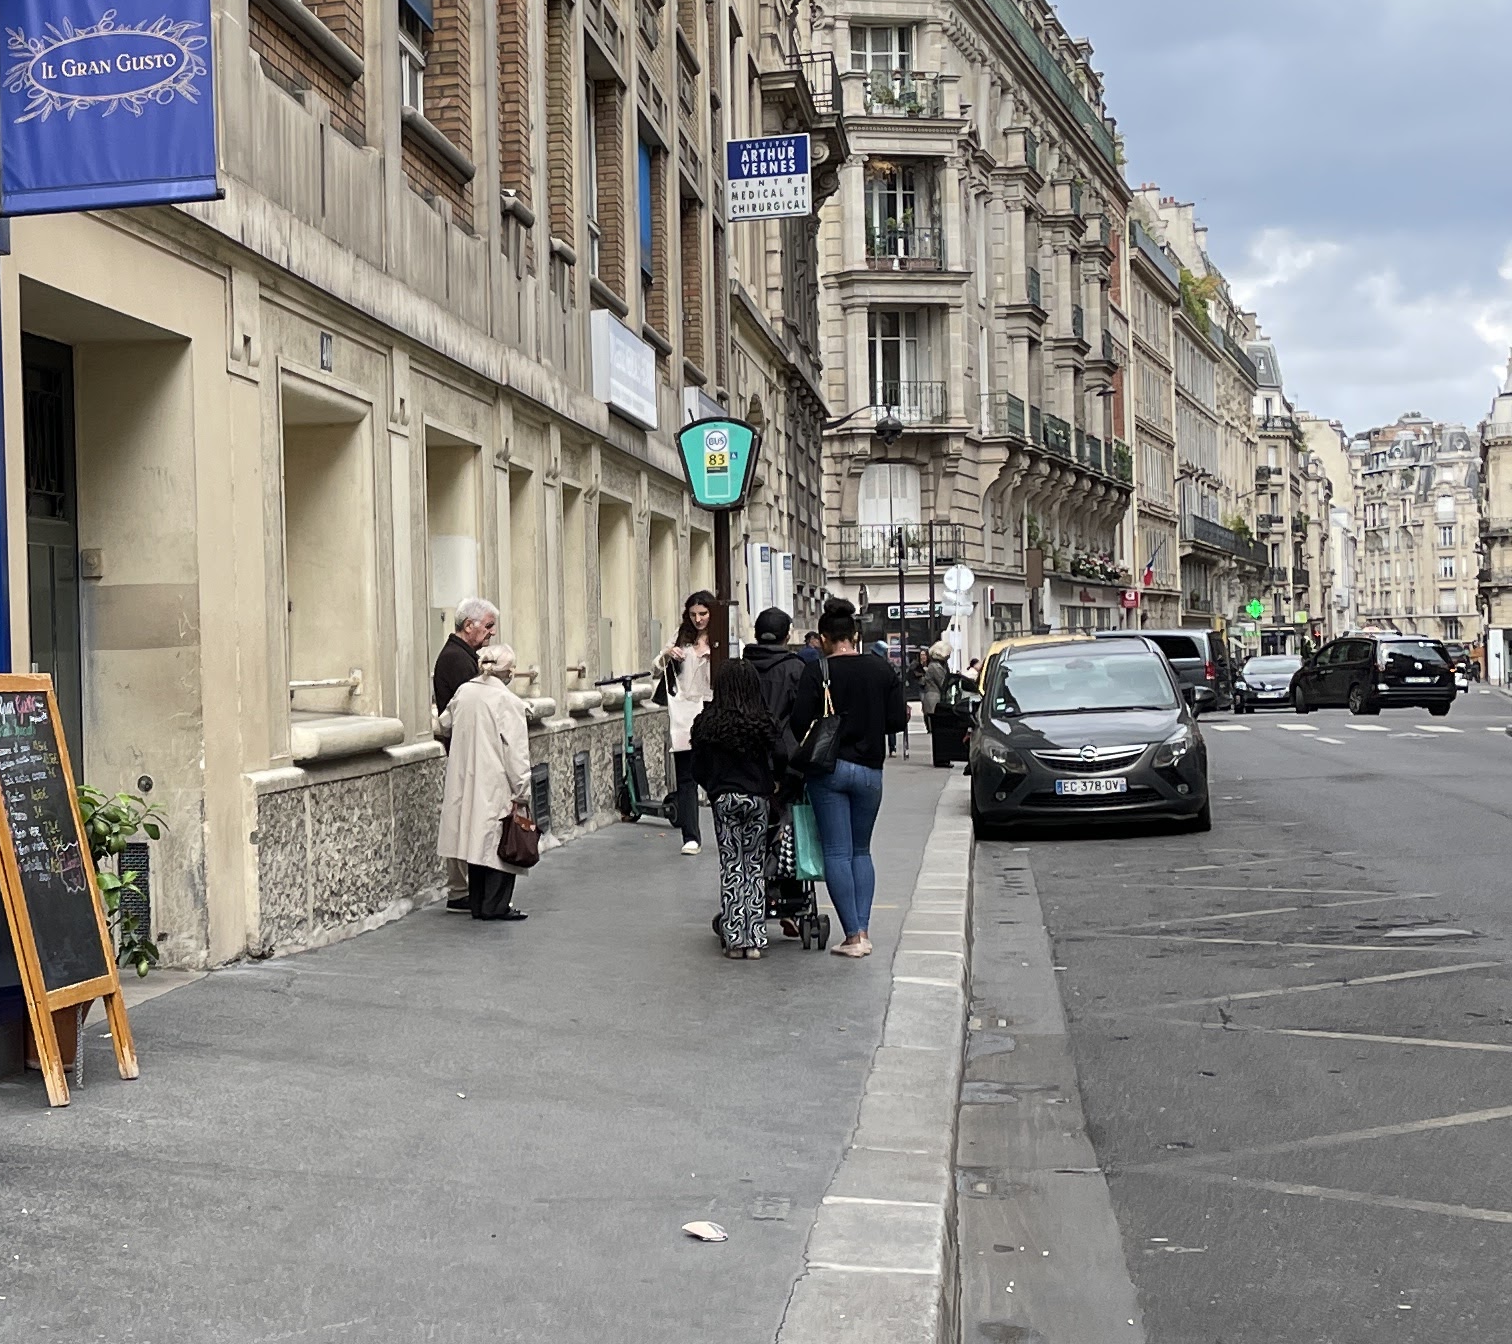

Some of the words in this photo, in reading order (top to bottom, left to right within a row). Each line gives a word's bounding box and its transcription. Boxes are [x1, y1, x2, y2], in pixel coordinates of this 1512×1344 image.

[739, 139, 795, 150] INSTITUT
[740, 146, 795, 163] ARTHUR
[740, 159, 796, 177] VERNES
[731, 176, 806, 189] CENTRE
[731, 187, 784, 201] MEDICAL
[793, 185, 806, 197] ET
[731, 199, 807, 215] CHIRURGICAL
[708, 453, 726, 466] 83
